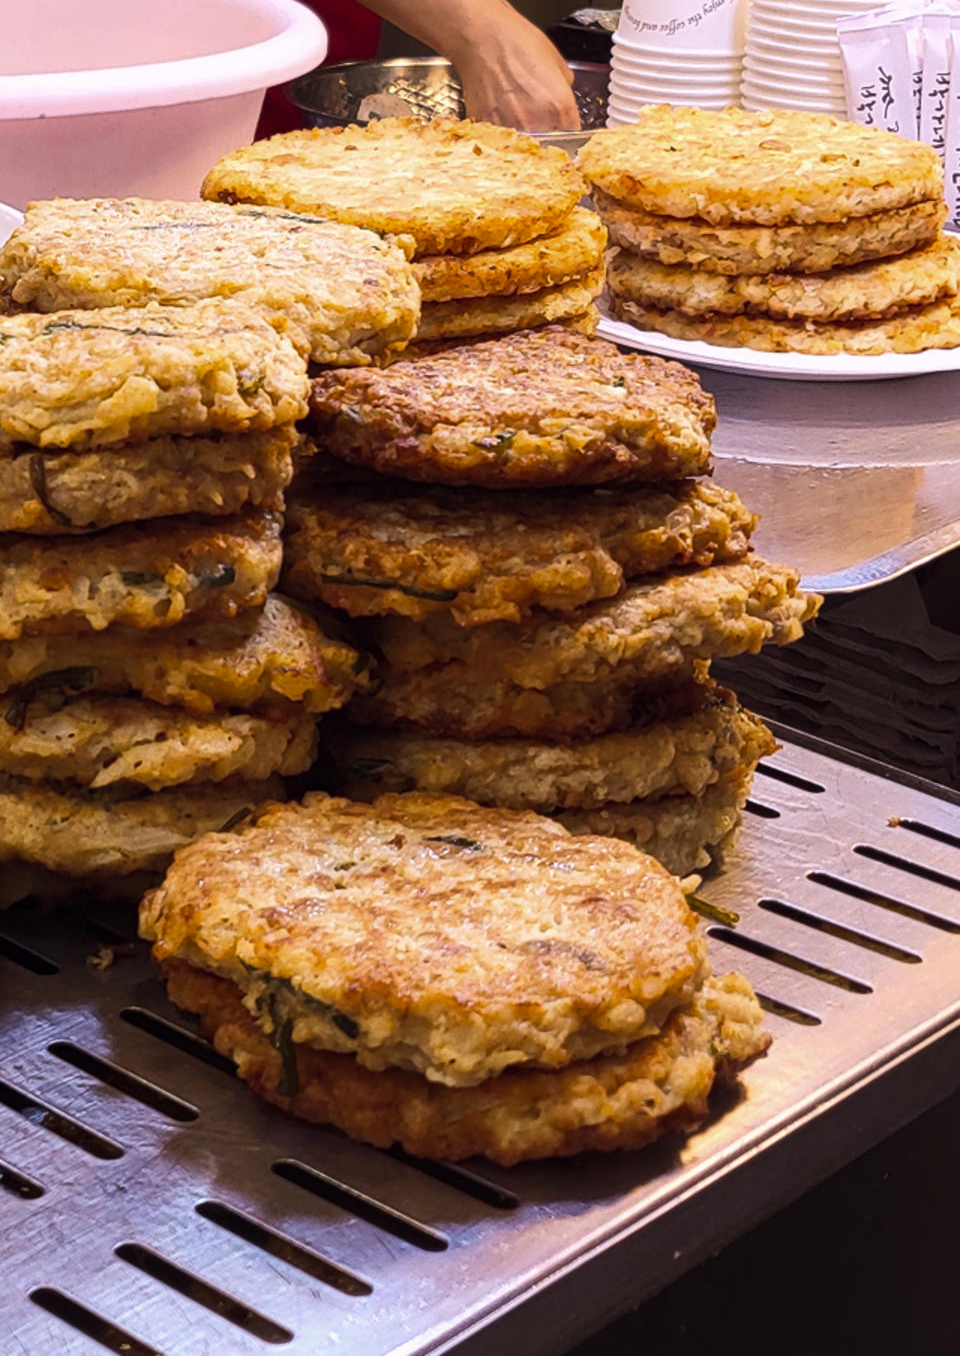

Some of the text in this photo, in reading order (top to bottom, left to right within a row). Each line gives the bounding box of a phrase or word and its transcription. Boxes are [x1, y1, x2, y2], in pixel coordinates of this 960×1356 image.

[640, 21, 658, 33] and
[659, 18, 686, 36] coffee
[687, 12, 702, 28] the
